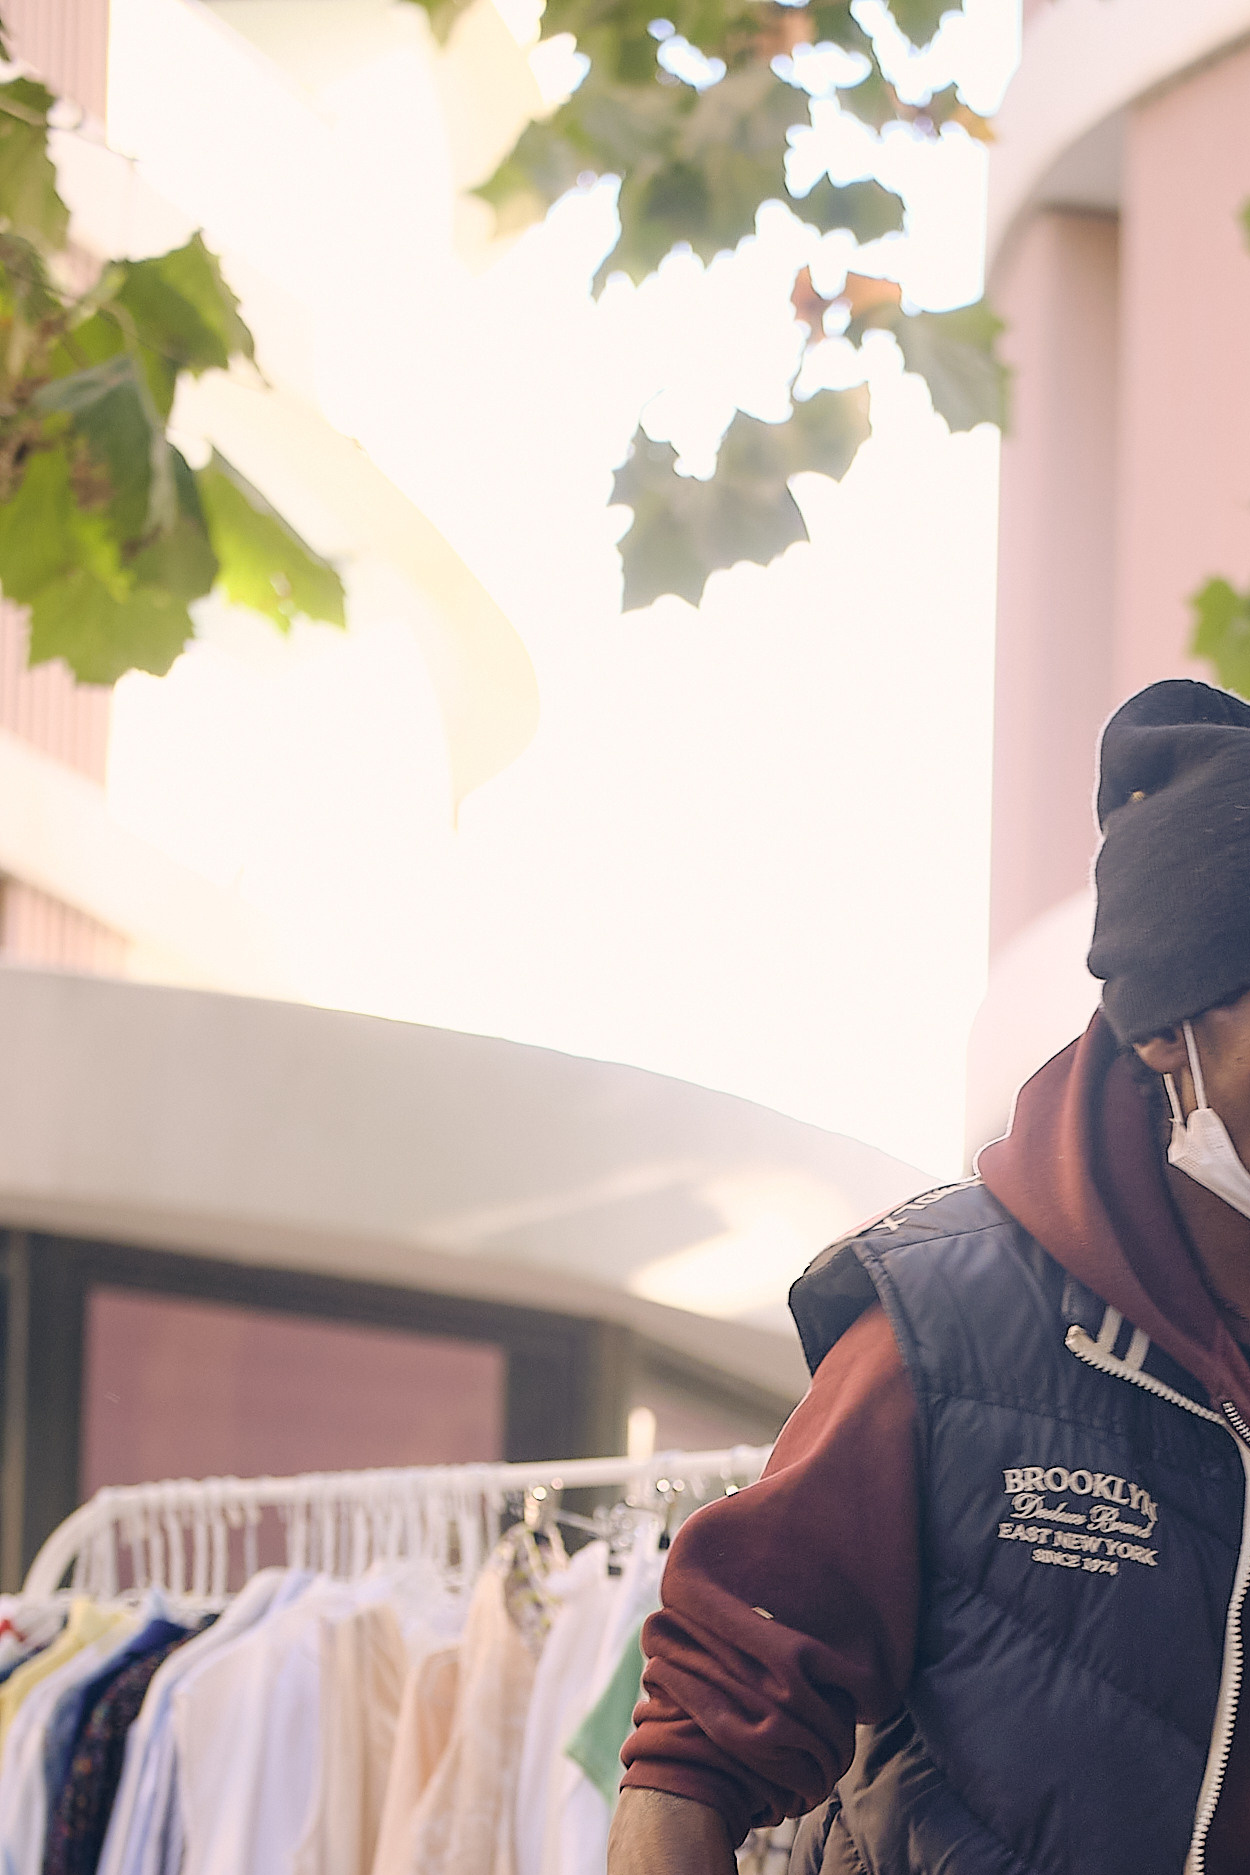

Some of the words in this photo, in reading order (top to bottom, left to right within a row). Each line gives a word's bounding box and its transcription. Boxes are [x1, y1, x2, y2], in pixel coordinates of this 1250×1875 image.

[1002, 1466, 1158, 1522] BROOKLYN
[998, 1522, 1053, 1545] EAST
[1052, 1530, 1106, 1553] NEW
[1105, 1537, 1158, 1567] YORK
[1031, 1548, 1082, 1568] SINCE
